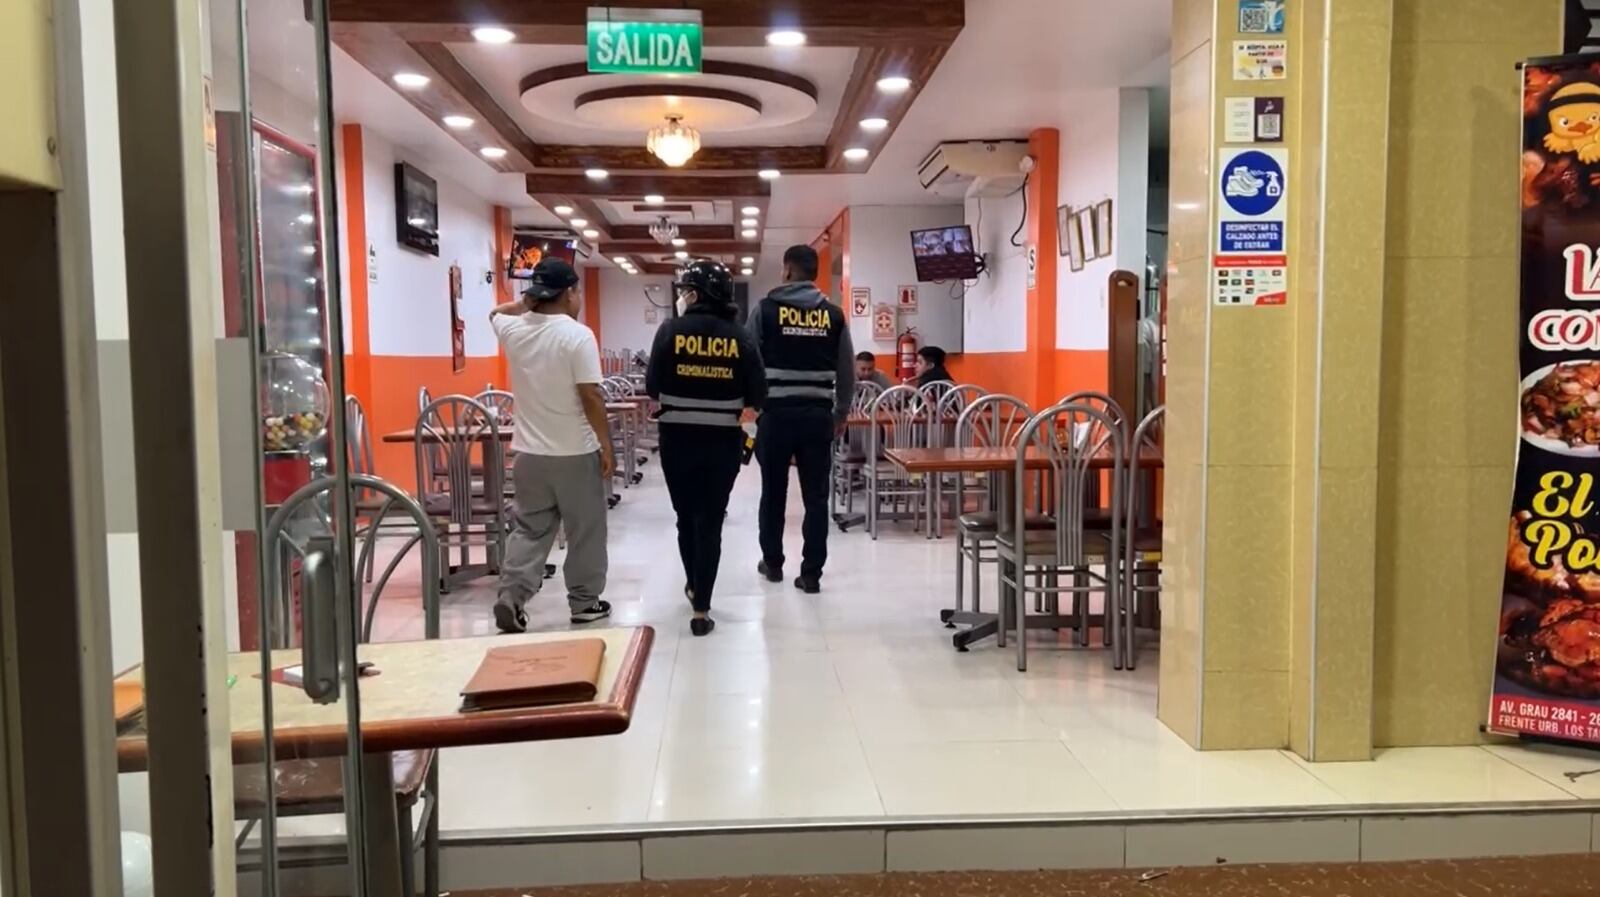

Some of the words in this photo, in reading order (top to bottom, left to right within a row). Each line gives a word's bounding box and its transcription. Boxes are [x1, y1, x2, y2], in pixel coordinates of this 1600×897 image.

[596, 31, 694, 67] SALIDA
[779, 306, 831, 329] POLICIA
[1528, 309, 1600, 351] CO
[675, 334, 740, 359] POLICIA
[1532, 470, 1594, 518] El
[1525, 519, 1600, 570] Po
[1498, 715, 1538, 731] FRENTE
[1538, 720, 1562, 735] URB.
[1564, 723, 1585, 738] LOS
[1499, 700, 1517, 715] AV.
[1519, 702, 1549, 719] GRAU
[1551, 706, 1578, 723] 2841
